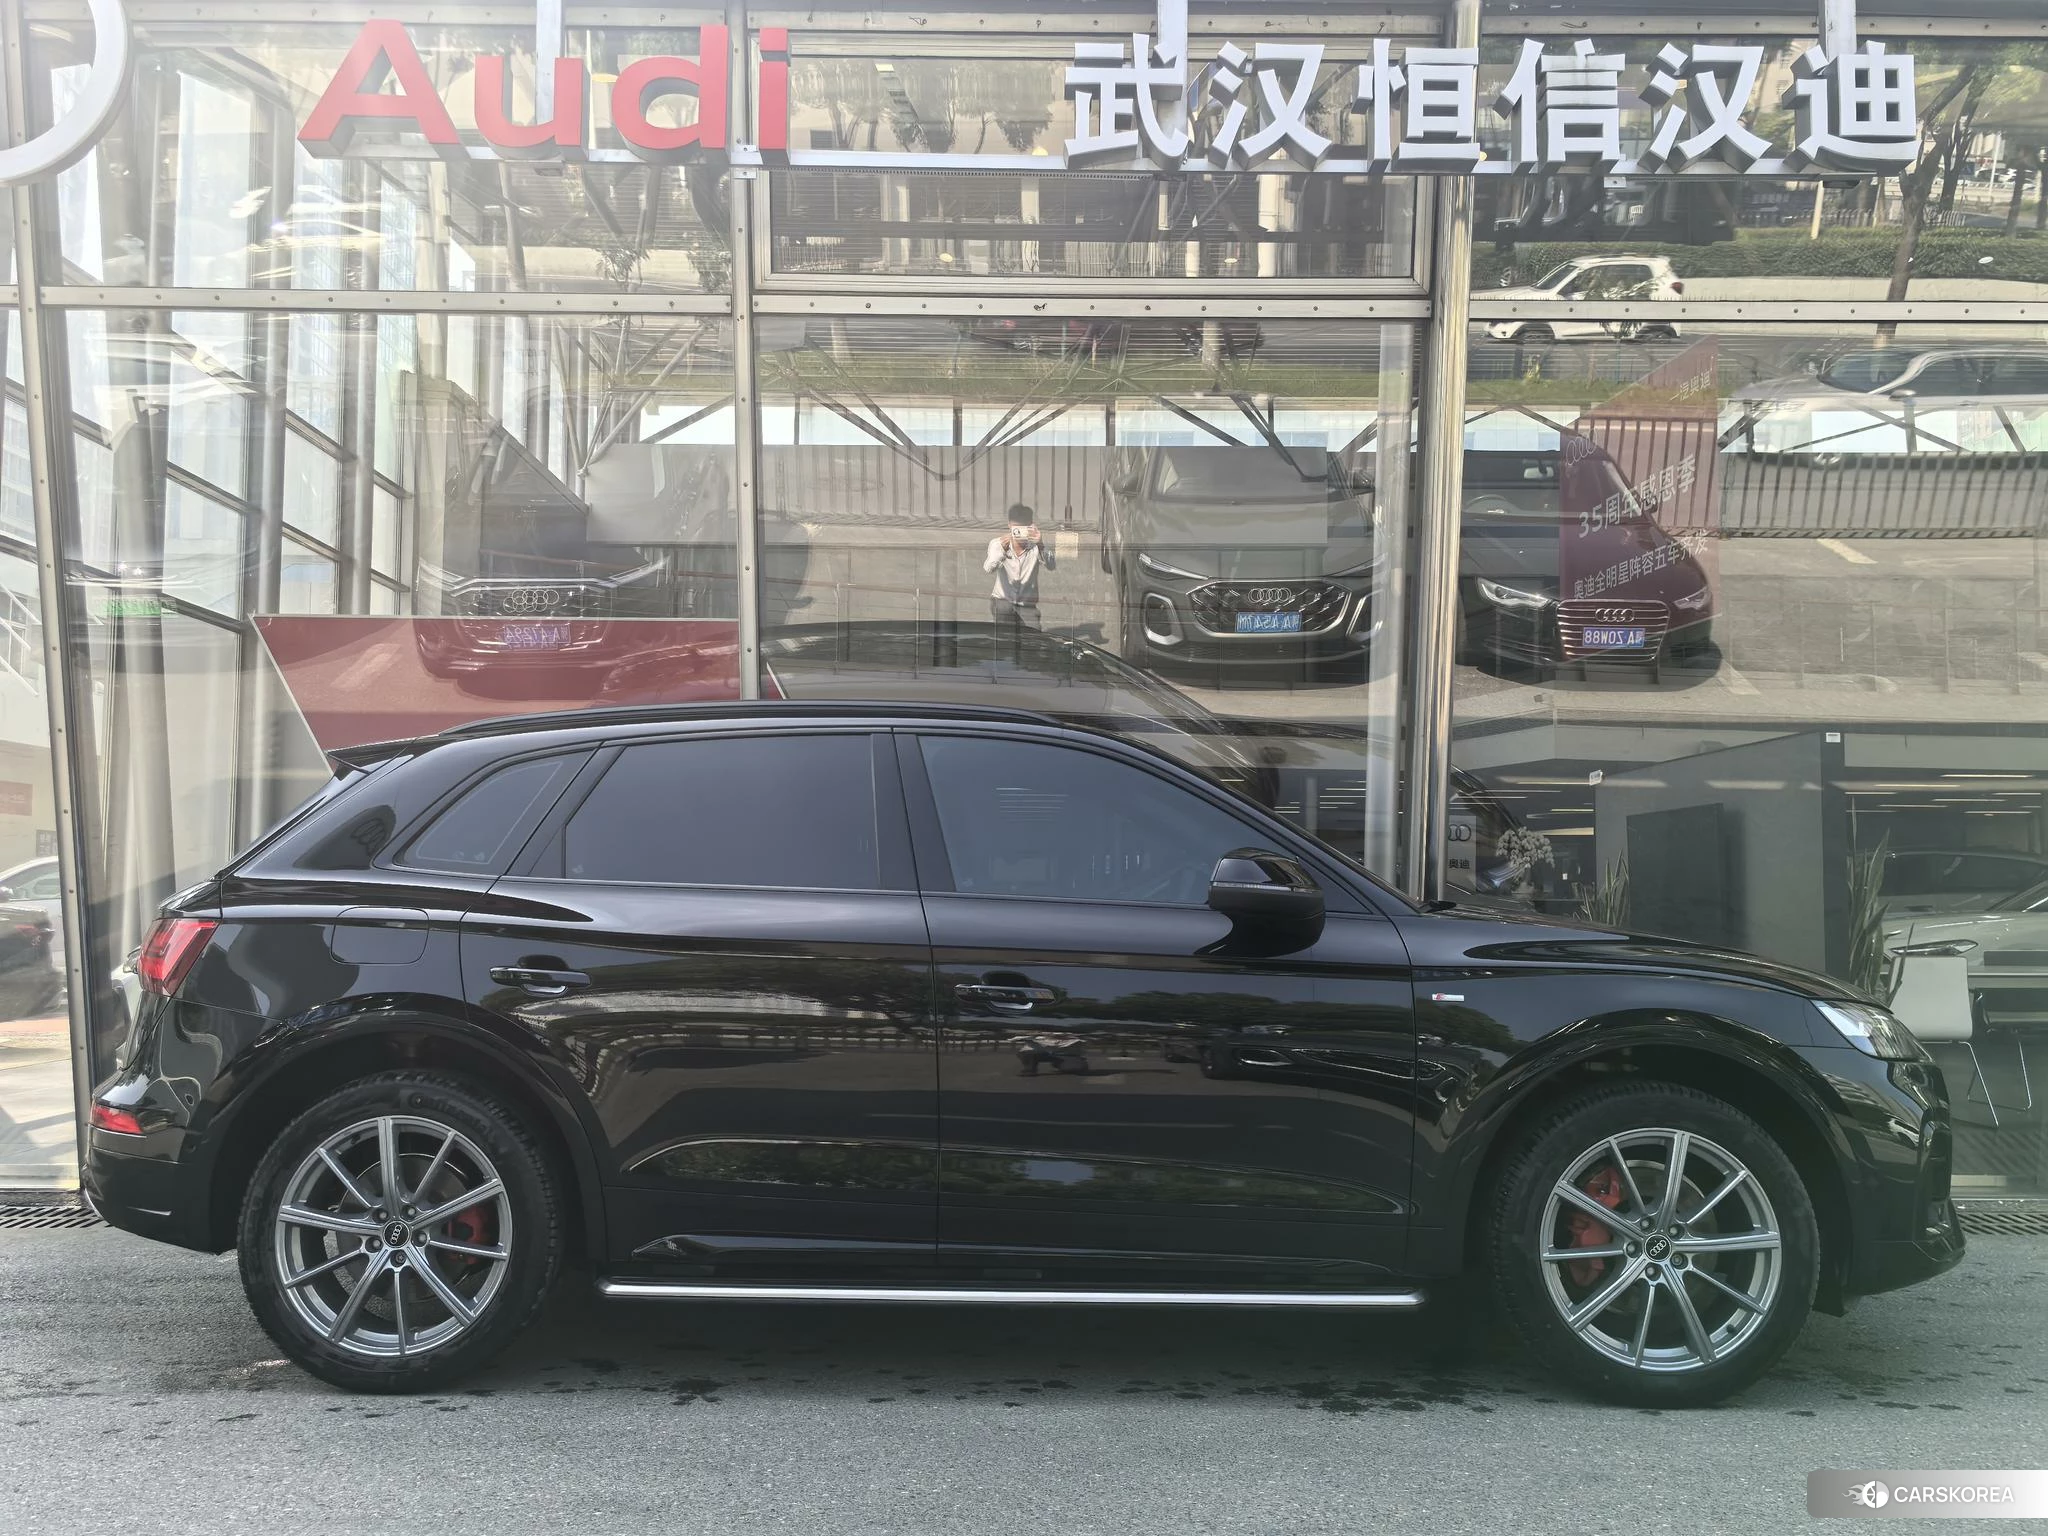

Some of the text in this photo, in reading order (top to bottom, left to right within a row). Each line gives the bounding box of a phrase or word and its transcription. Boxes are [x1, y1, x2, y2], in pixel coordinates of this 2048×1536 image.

[297, 18, 789, 152] Audi
[1064, 32, 1922, 167] 武汉恒信汉迪
[1578, 453, 1697, 539] 35周年感恩季
[1573, 529, 1709, 601] 奥迪全明星阵容五车齐发
